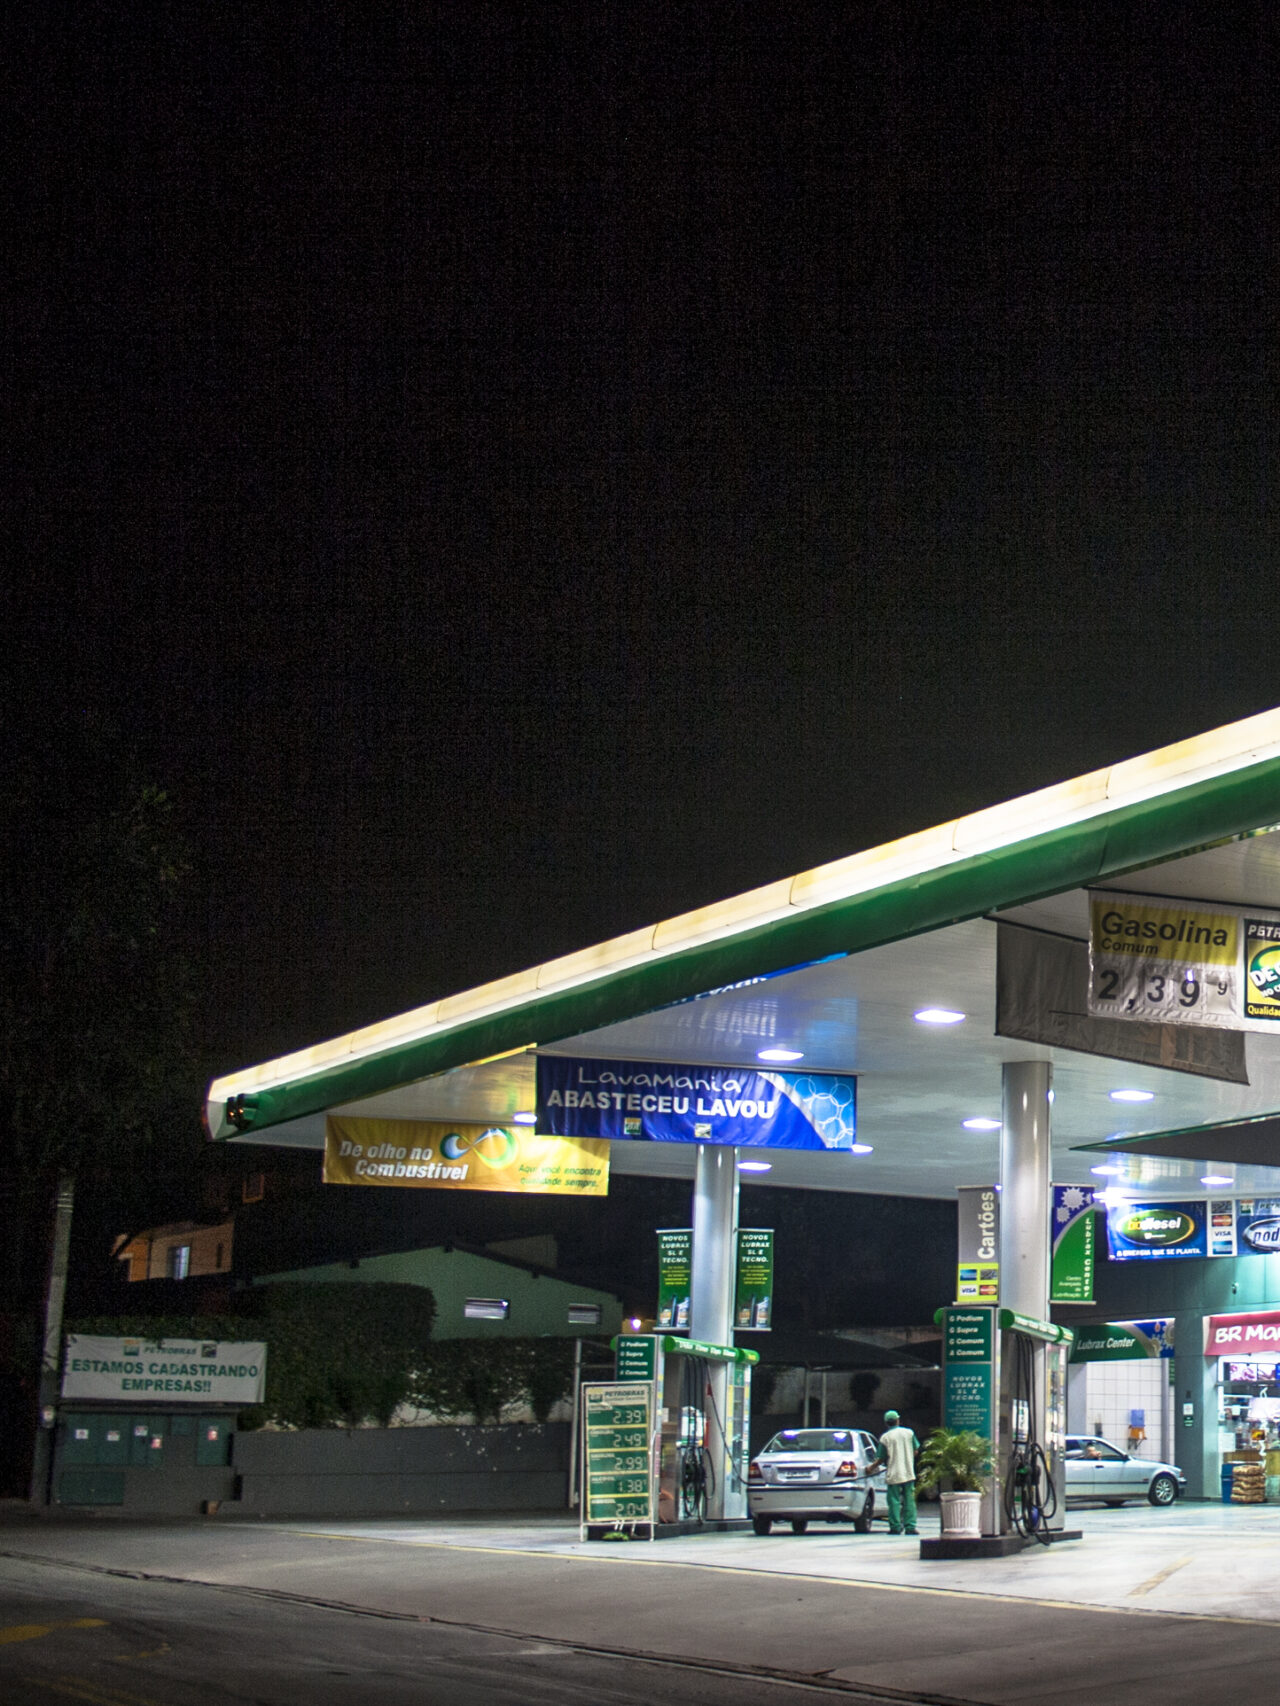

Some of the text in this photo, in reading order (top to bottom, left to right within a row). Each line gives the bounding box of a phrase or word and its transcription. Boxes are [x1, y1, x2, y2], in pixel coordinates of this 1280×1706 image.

[1101, 911, 1228, 947] Gasolina
[1102, 938, 1159, 955] Comum
[1250, 966, 1278, 987] DE
[579, 1067, 742, 1093] LavaMania
[547, 1090, 774, 1119] ABASTECEU LAVOU
[340, 1141, 433, 1161] De olho no
[355, 1159, 469, 1181] Combustível
[978, 1192, 995, 1260] Cartões
[1077, 1337, 1135, 1350] Lubrax Center
[1215, 1326, 1242, 1344] BR
[72, 1359, 258, 1377] ESTAMOS CADASTRANDO
[122, 1378, 211, 1392] EMPRESAS!!
